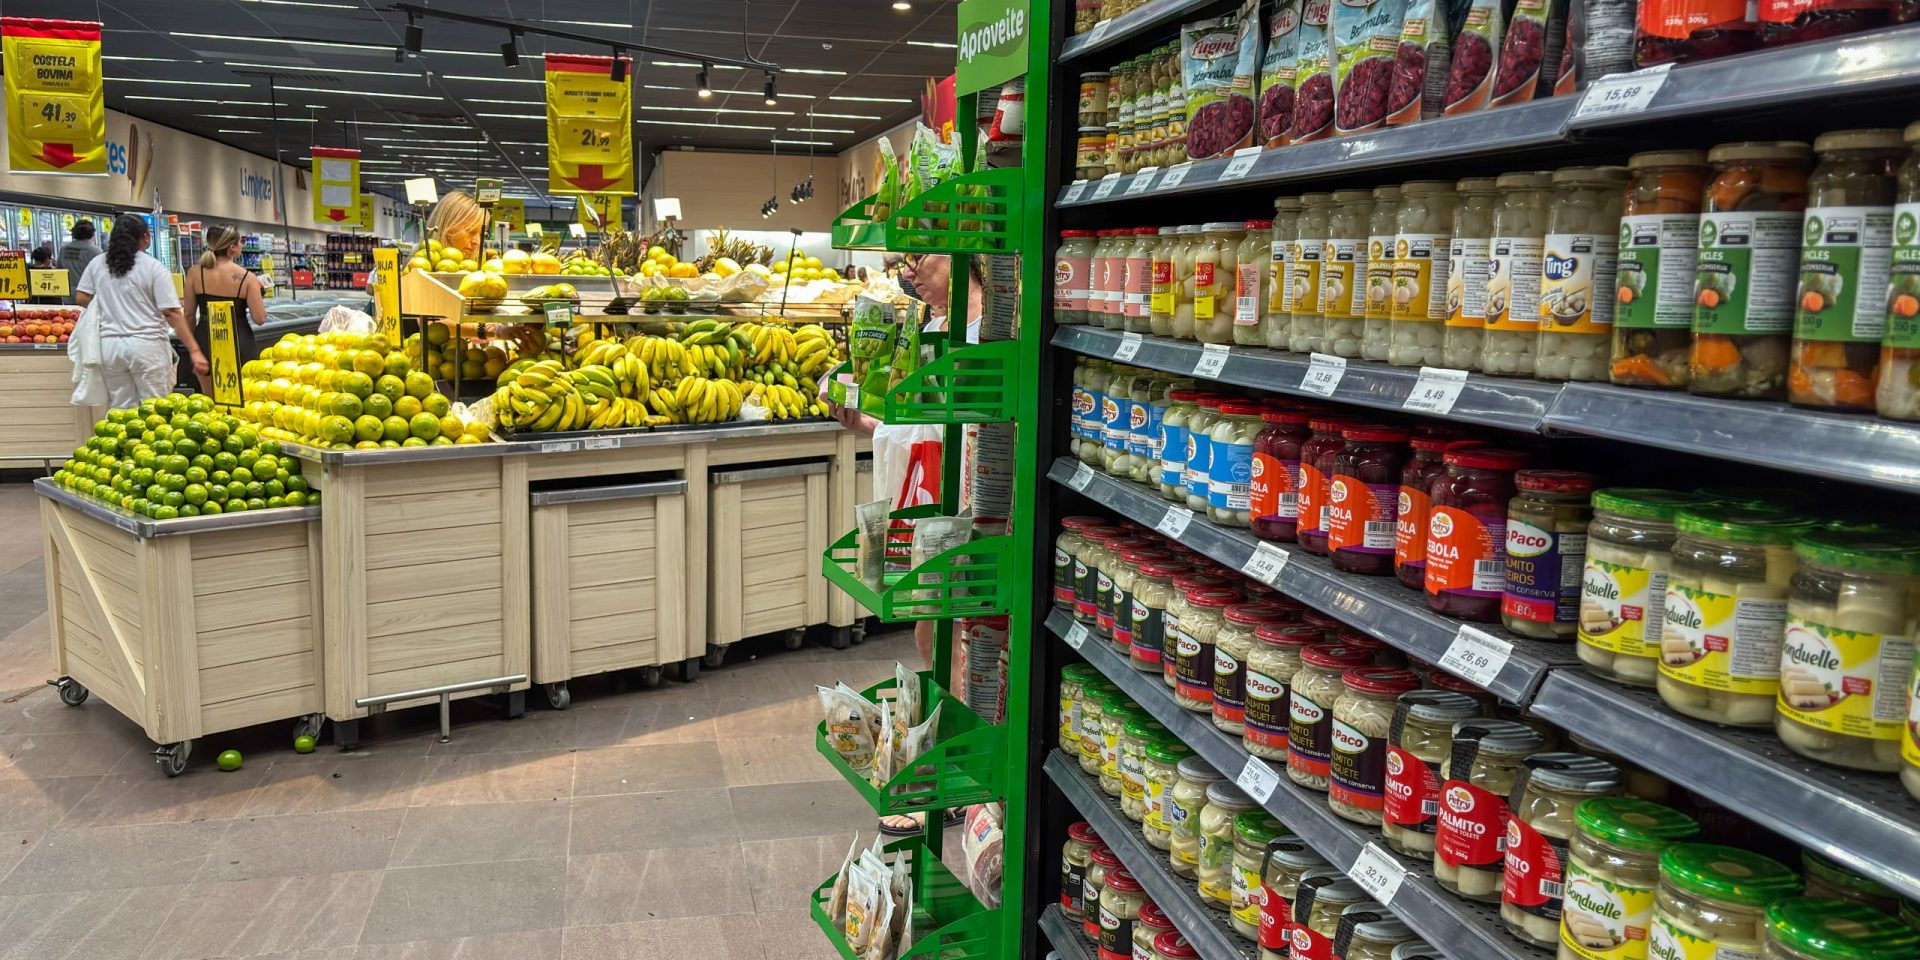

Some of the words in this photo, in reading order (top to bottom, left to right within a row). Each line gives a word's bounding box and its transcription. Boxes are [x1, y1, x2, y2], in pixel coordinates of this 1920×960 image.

[960, 8, 1024, 63] Aproveite
[1192, 38, 1236, 59] Fugini
[33, 54, 76, 67] COSTELA
[37, 68, 74, 81] BOVINA
[1604, 86, 1642, 101] 15,69
[41, 102, 77, 123] 41,39
[106, 141, 126, 174] es
[240, 168, 272, 214] Limpeza
[1545, 257, 1573, 277] Ting
[213, 357, 237, 393] 6,29
[1424, 388, 1445, 400] 8,49
[1433, 521, 1450, 534] Petry
[1510, 530, 1547, 548] Paco
[1516, 584, 1555, 598] conserva
[1178, 637, 1198, 651] Paco
[1216, 655, 1234, 670] Paco
[1461, 650, 1489, 668] 26,69
[1252, 680, 1280, 694] Paco
[1293, 701, 1319, 719] Paco
[1335, 729, 1364, 748] Paco
[1304, 748, 1330, 758] conserva
[1348, 780, 1376, 790] conserva
[1448, 793, 1471, 810] Petry
[1440, 806, 1486, 835] PALMITO
[1459, 829, 1480, 840] TOLETE
[1365, 865, 1387, 887] 32,19
[1565, 880, 1622, 920] Bonduelle
